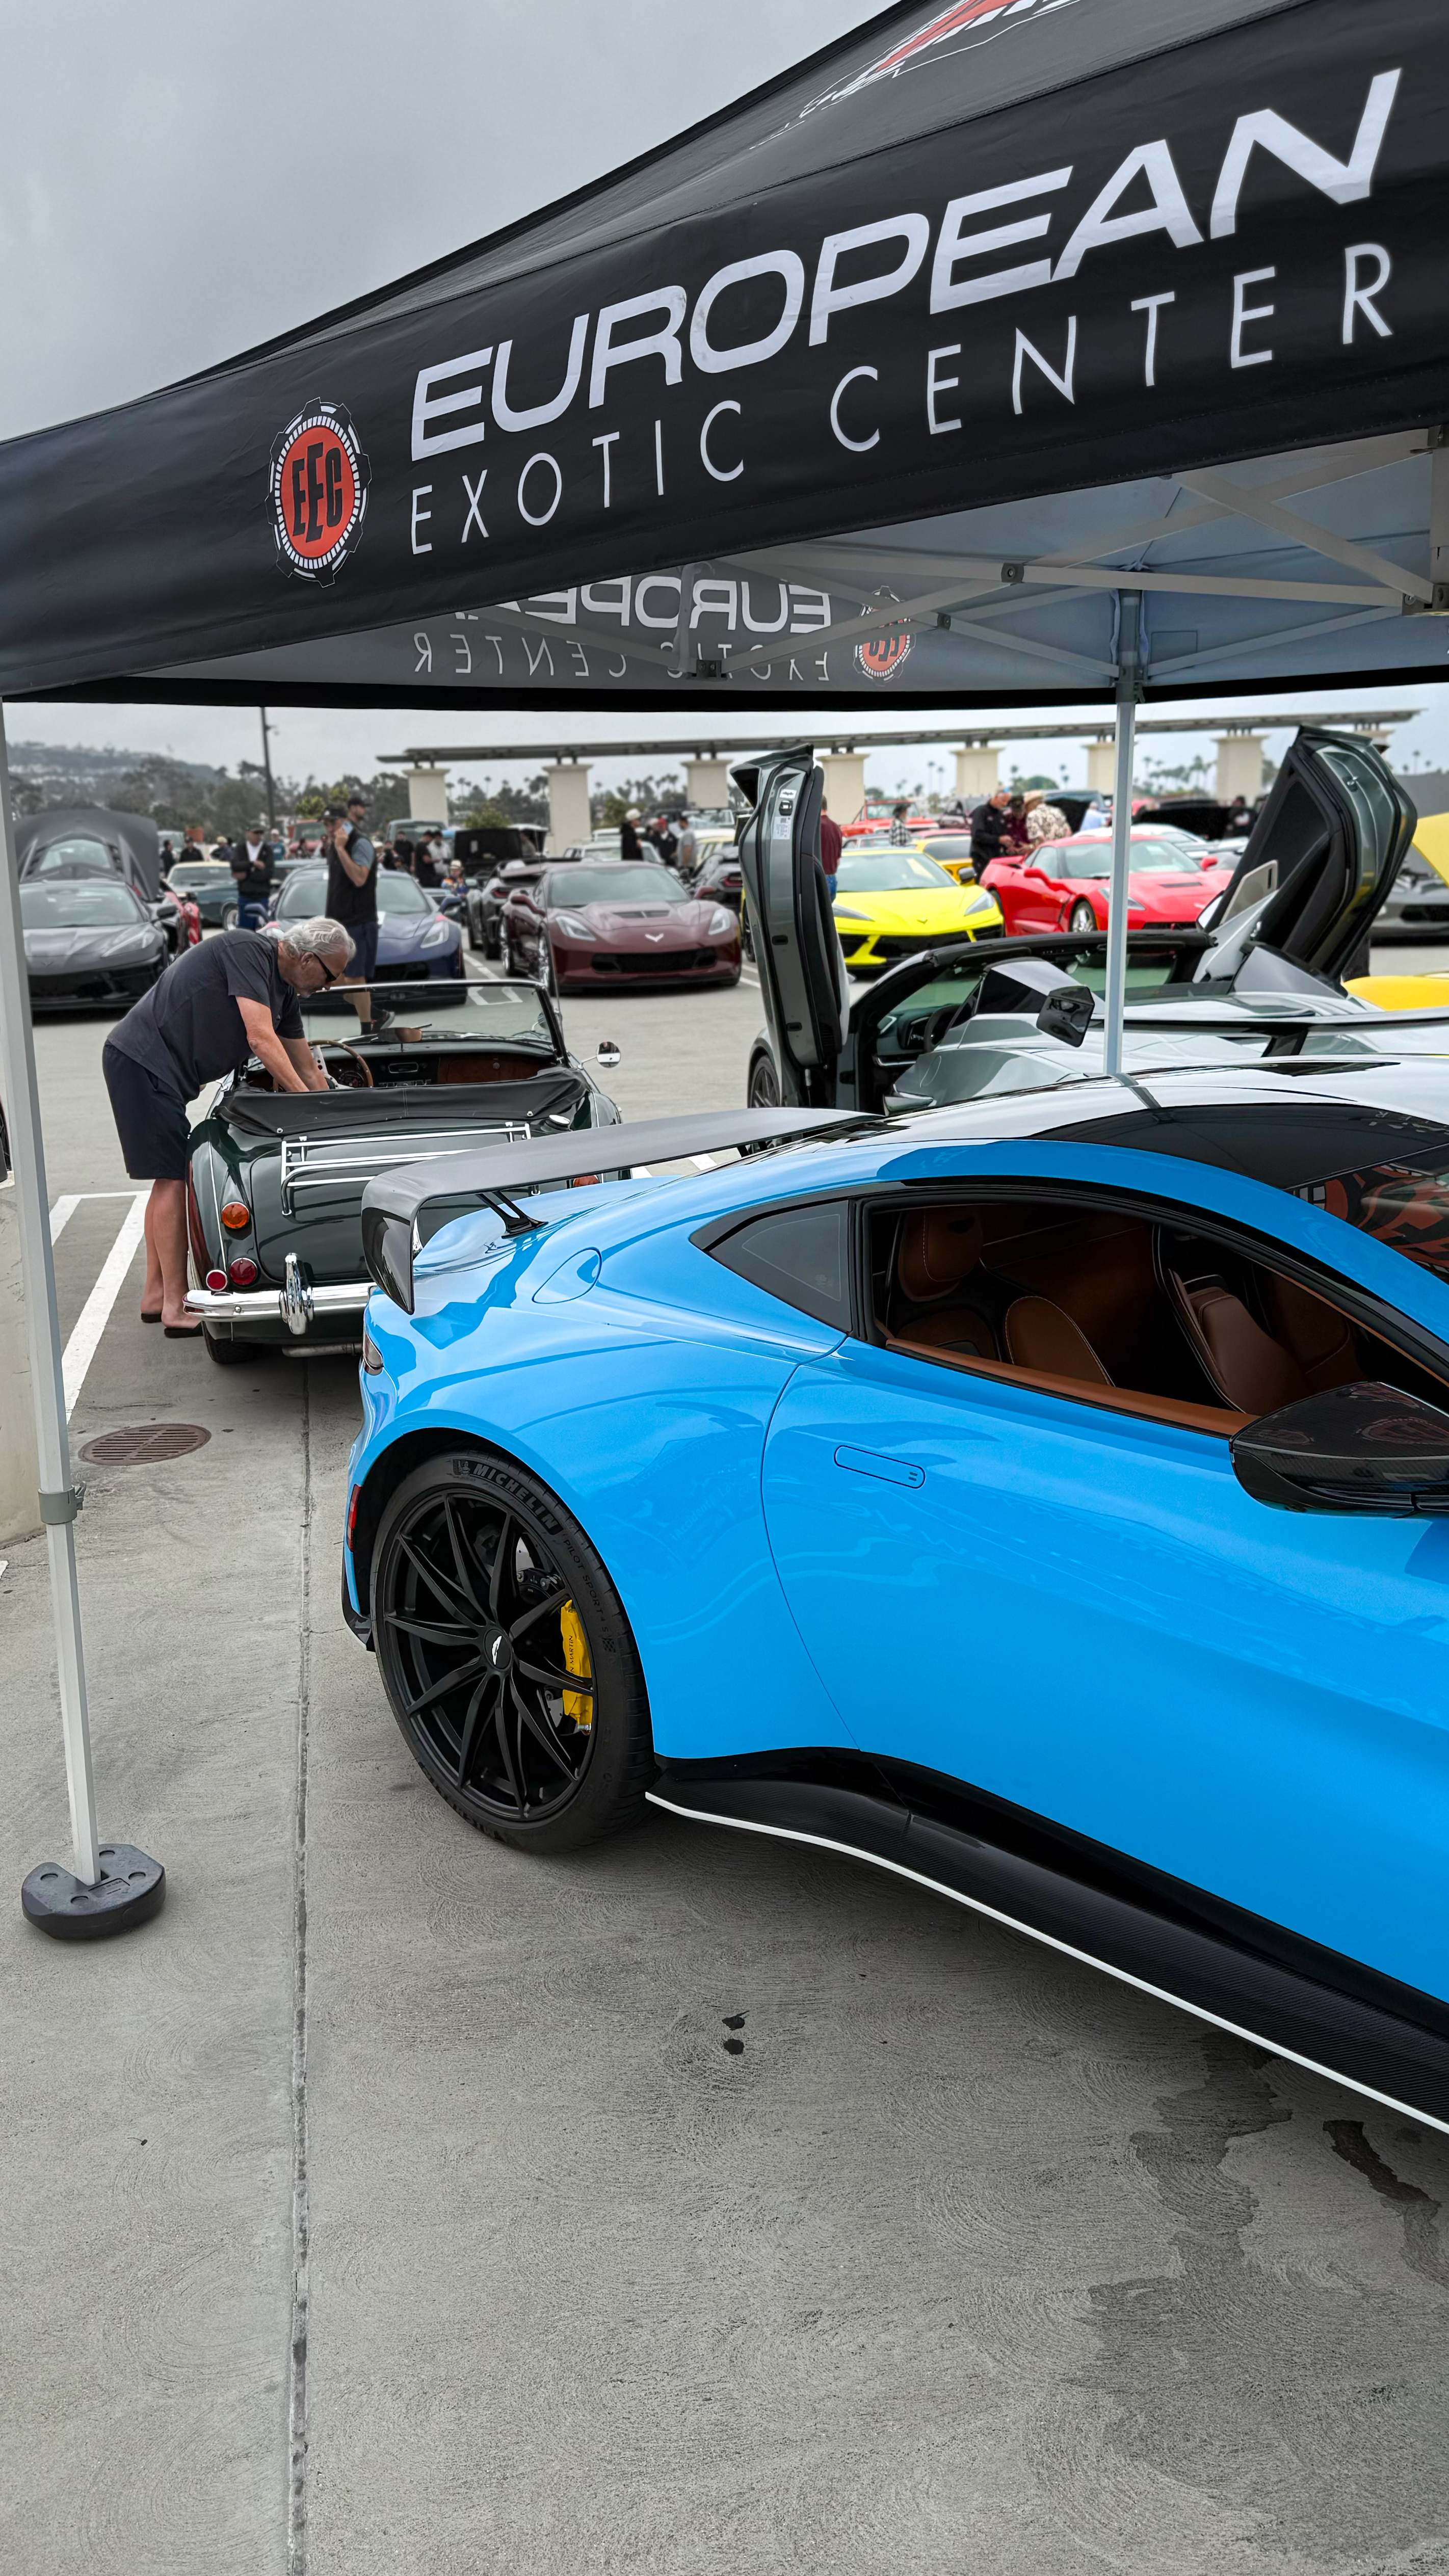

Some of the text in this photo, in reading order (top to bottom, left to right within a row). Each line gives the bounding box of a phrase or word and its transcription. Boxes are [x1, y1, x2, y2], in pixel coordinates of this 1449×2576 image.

[411, 68, 1402, 462] EUROPEAN
[411, 243, 1393, 556] EXOTIC CENTER
[292, 442, 343, 543] EEC
[472, 1463, 558, 1529] MICHELIN
[563, 1539, 585, 1570] PILOT
[583, 1575, 603, 1614] SPORT
